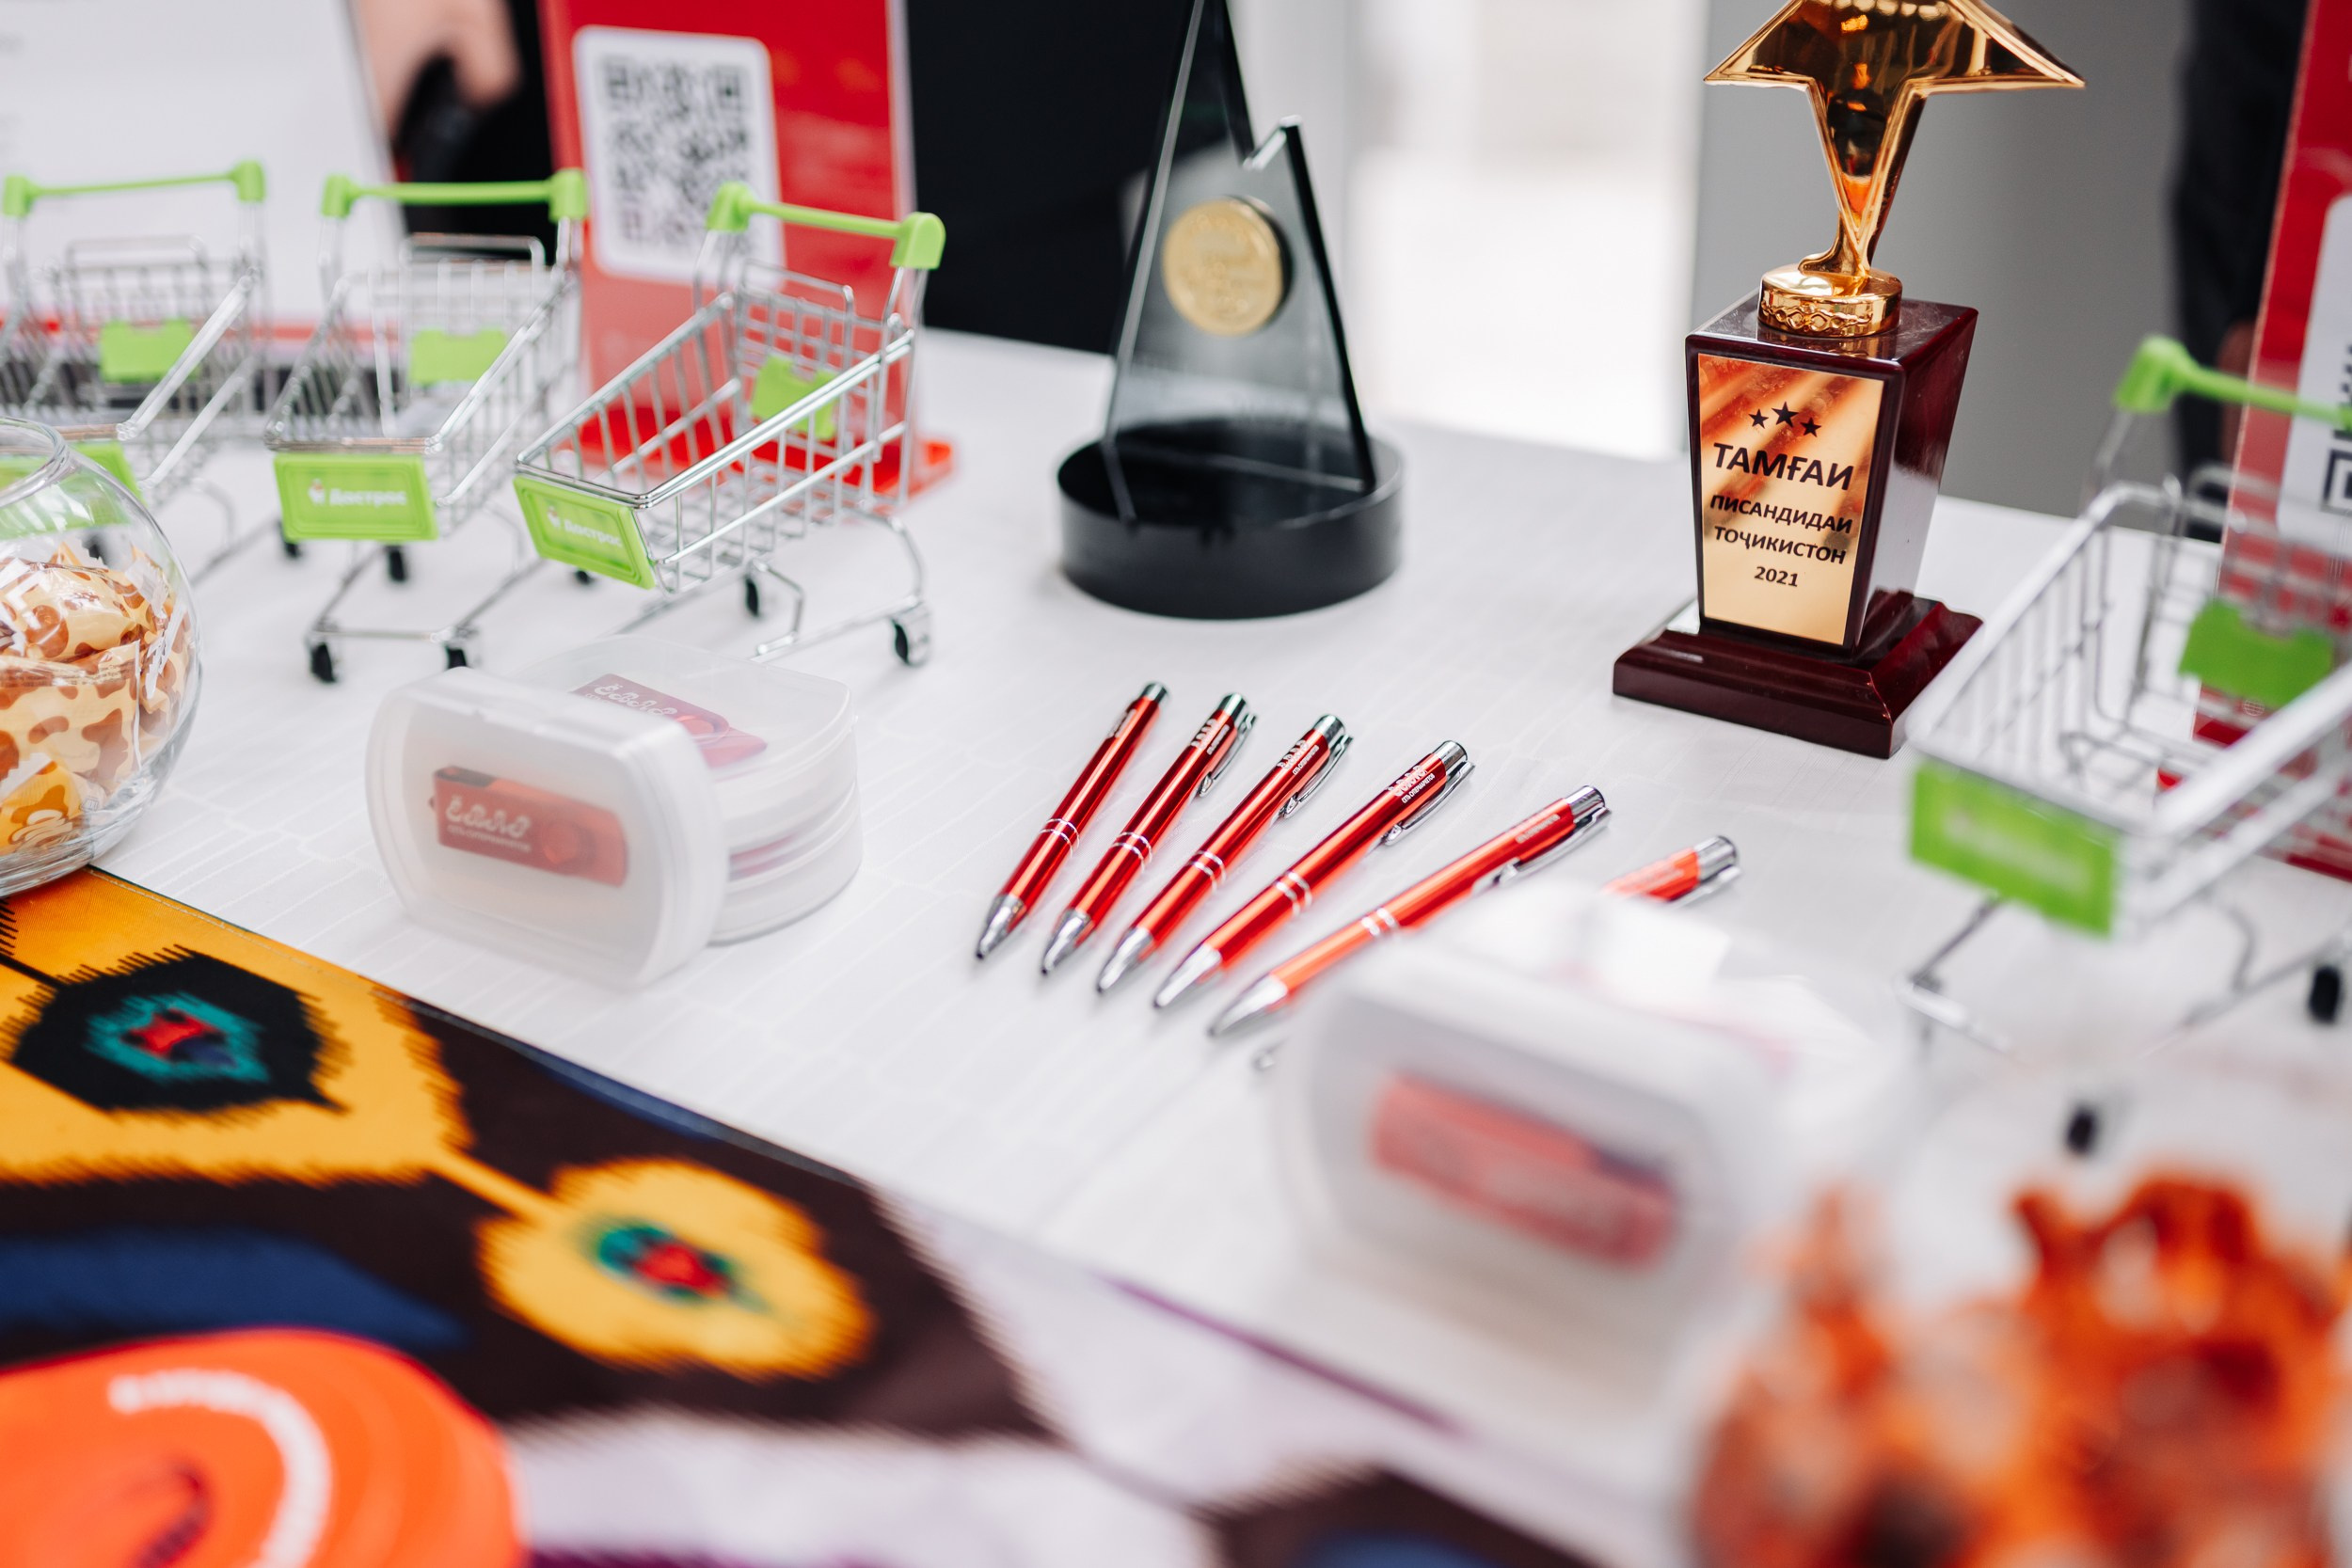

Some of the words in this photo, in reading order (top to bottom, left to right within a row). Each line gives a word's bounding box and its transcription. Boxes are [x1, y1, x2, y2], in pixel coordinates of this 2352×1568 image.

[1713, 443, 1854, 491] ТАМҒАИ
[1709, 495, 1852, 534] ПИСАНДИДАИ
[1714, 526, 1846, 564] ТОҶИКИСТОН
[1754, 566, 1799, 587] 2021
